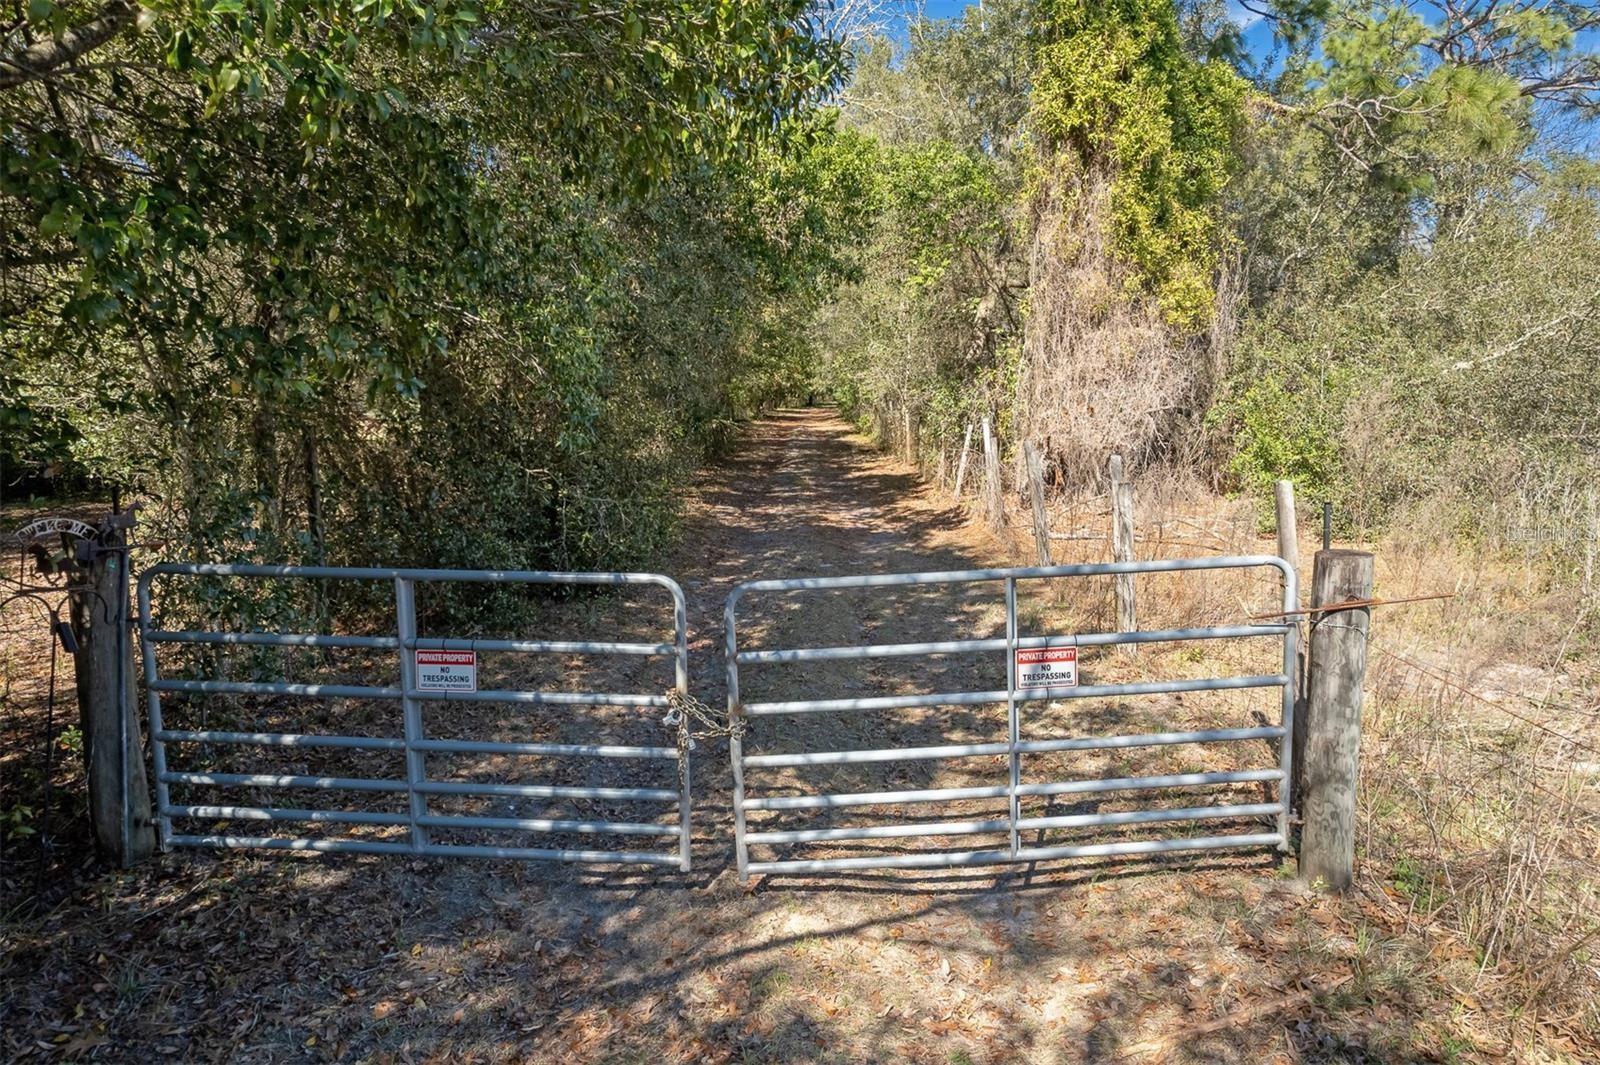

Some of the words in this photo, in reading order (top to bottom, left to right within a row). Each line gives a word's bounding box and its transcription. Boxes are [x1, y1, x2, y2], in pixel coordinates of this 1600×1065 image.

[418, 653, 443, 662] PRIVATE
[443, 654, 474, 663] PROPERTY
[1018, 652, 1043, 661] PRIVATE
[1043, 650, 1075, 660] PROPERTY
[440, 666, 450, 674] NO
[423, 675, 470, 683] TRESPASSING
[1022, 672, 1071, 681] TRESPASSING
